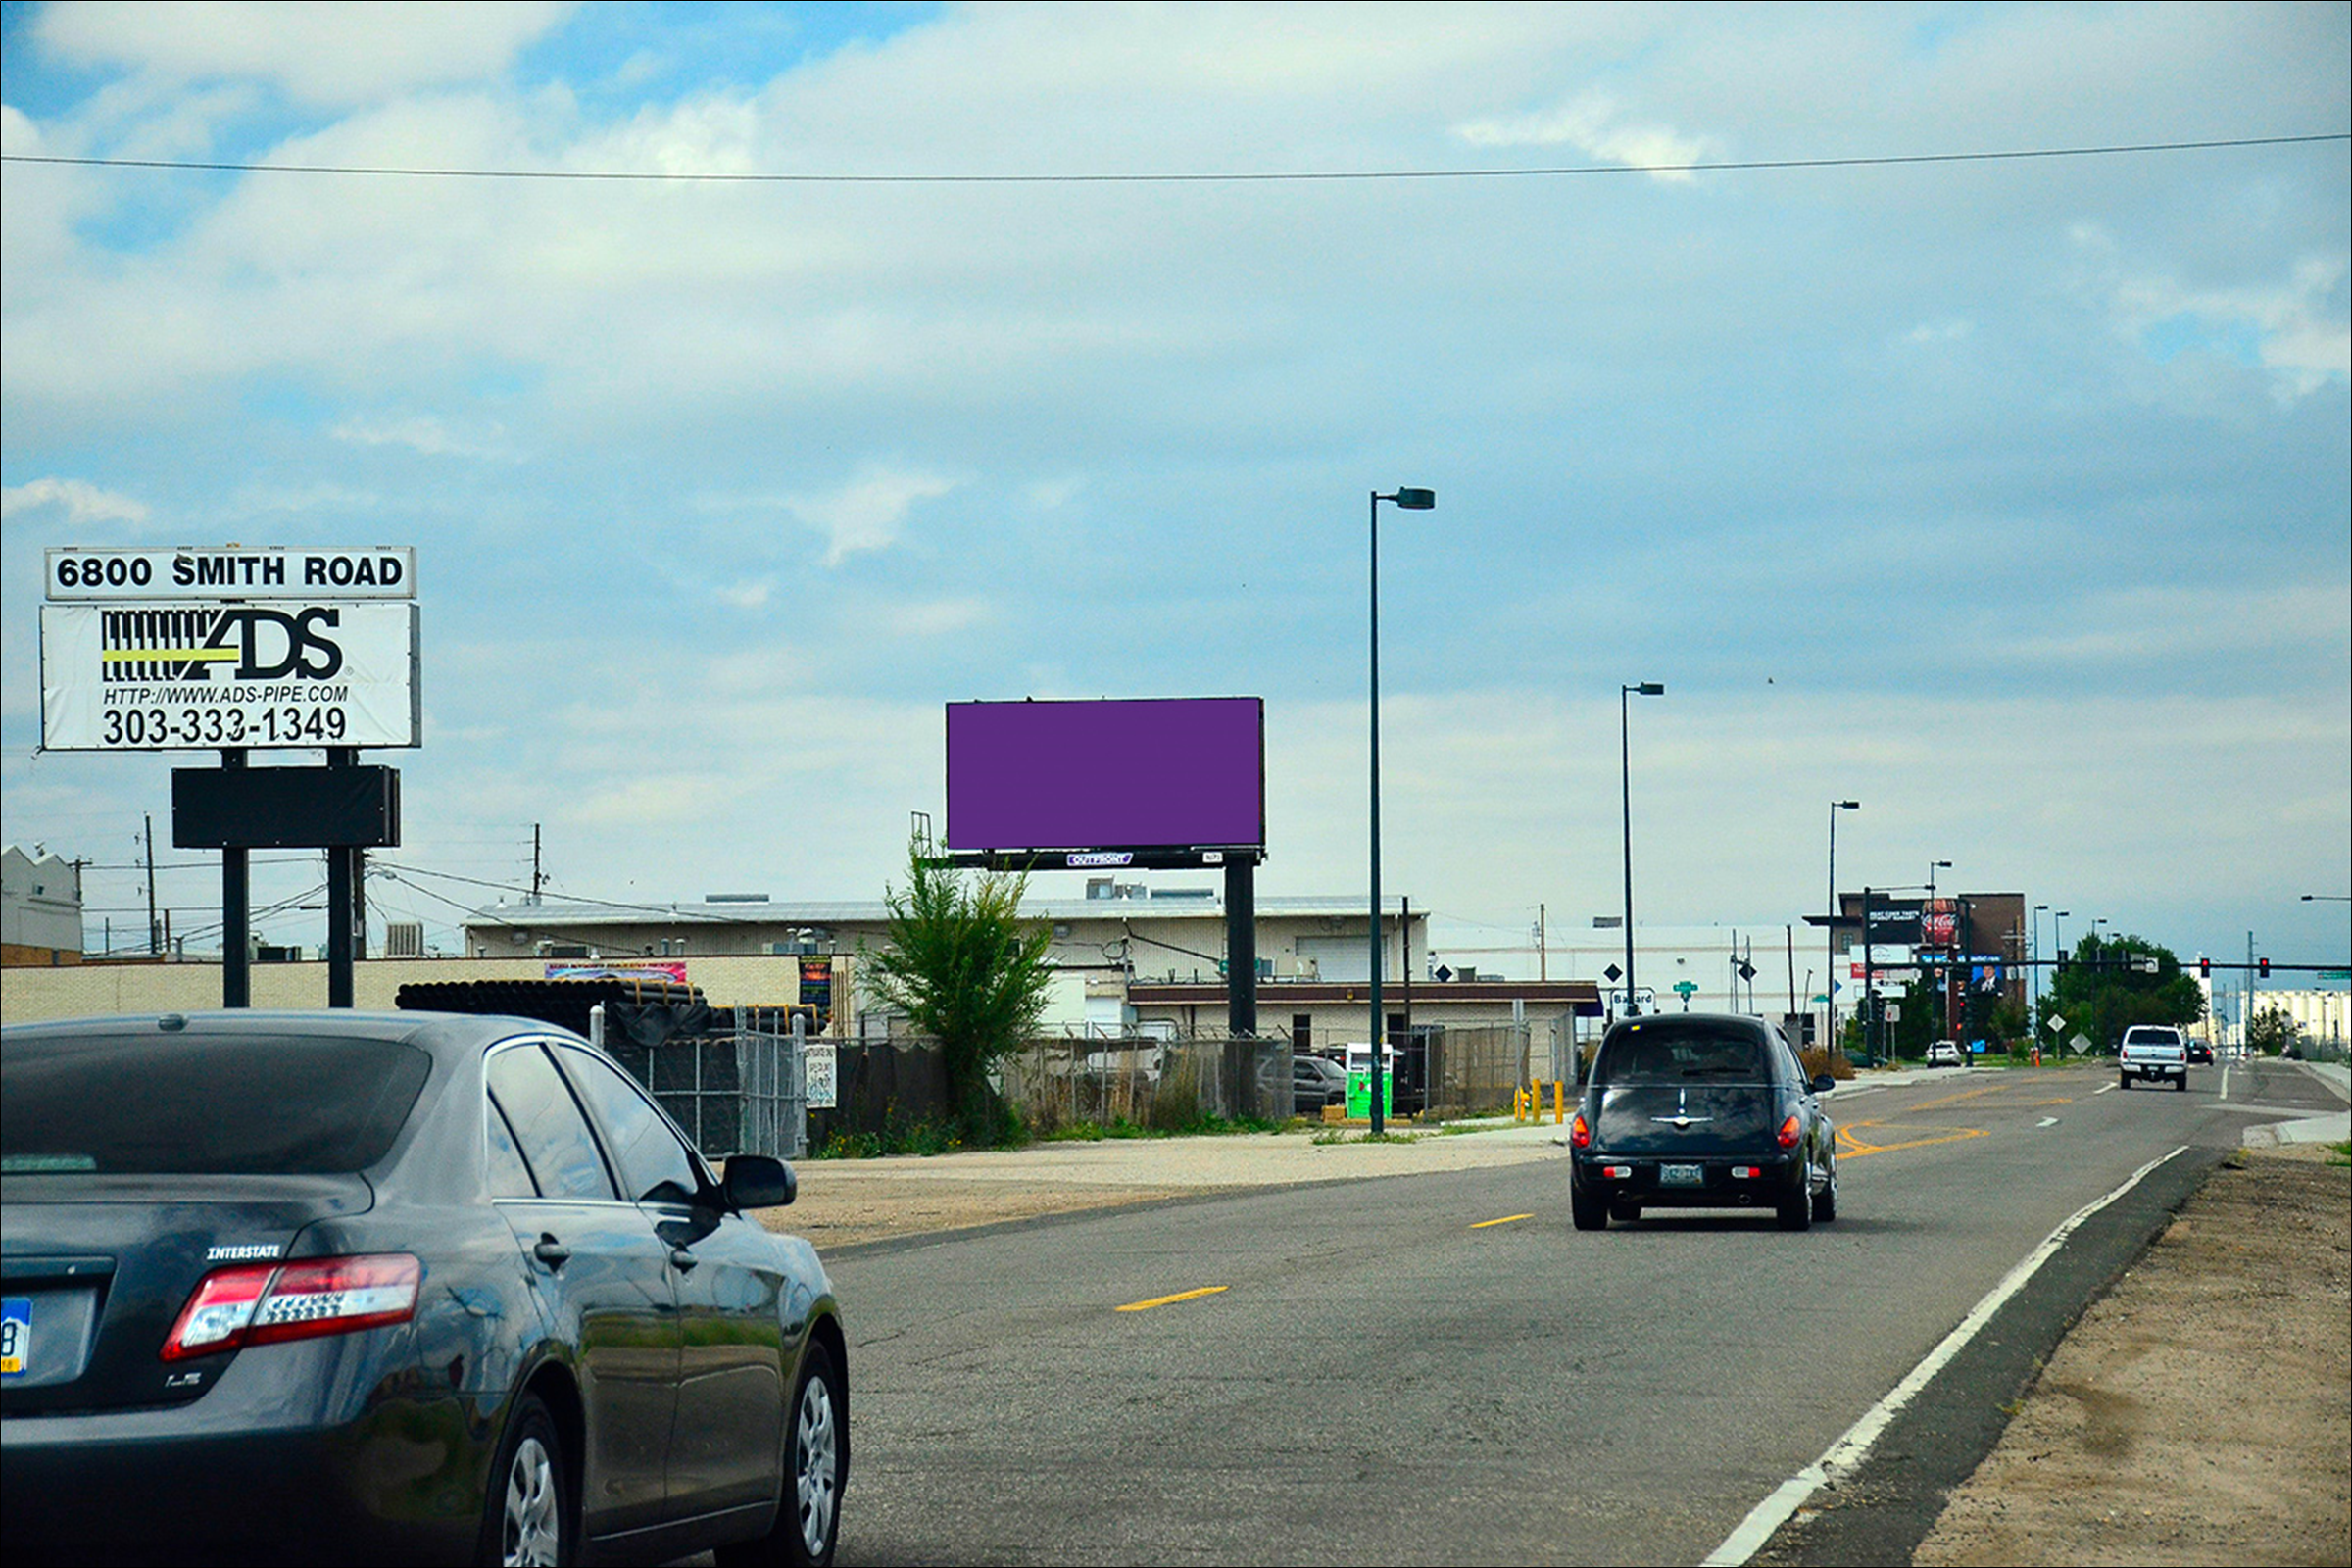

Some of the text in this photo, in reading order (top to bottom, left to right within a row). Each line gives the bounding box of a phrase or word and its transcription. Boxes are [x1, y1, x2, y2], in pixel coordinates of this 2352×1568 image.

[57, 556, 403, 587] 6800 SMITH ROAD
[181, 607, 343, 681] ADS
[103, 685, 349, 705] HTTP://WWW.ADS-PIPE.COM
[103, 707, 347, 745] 303-333-1349
[1613, 994, 1652, 1004] Baard
[206, 1245, 280, 1260] INTERSTATE
